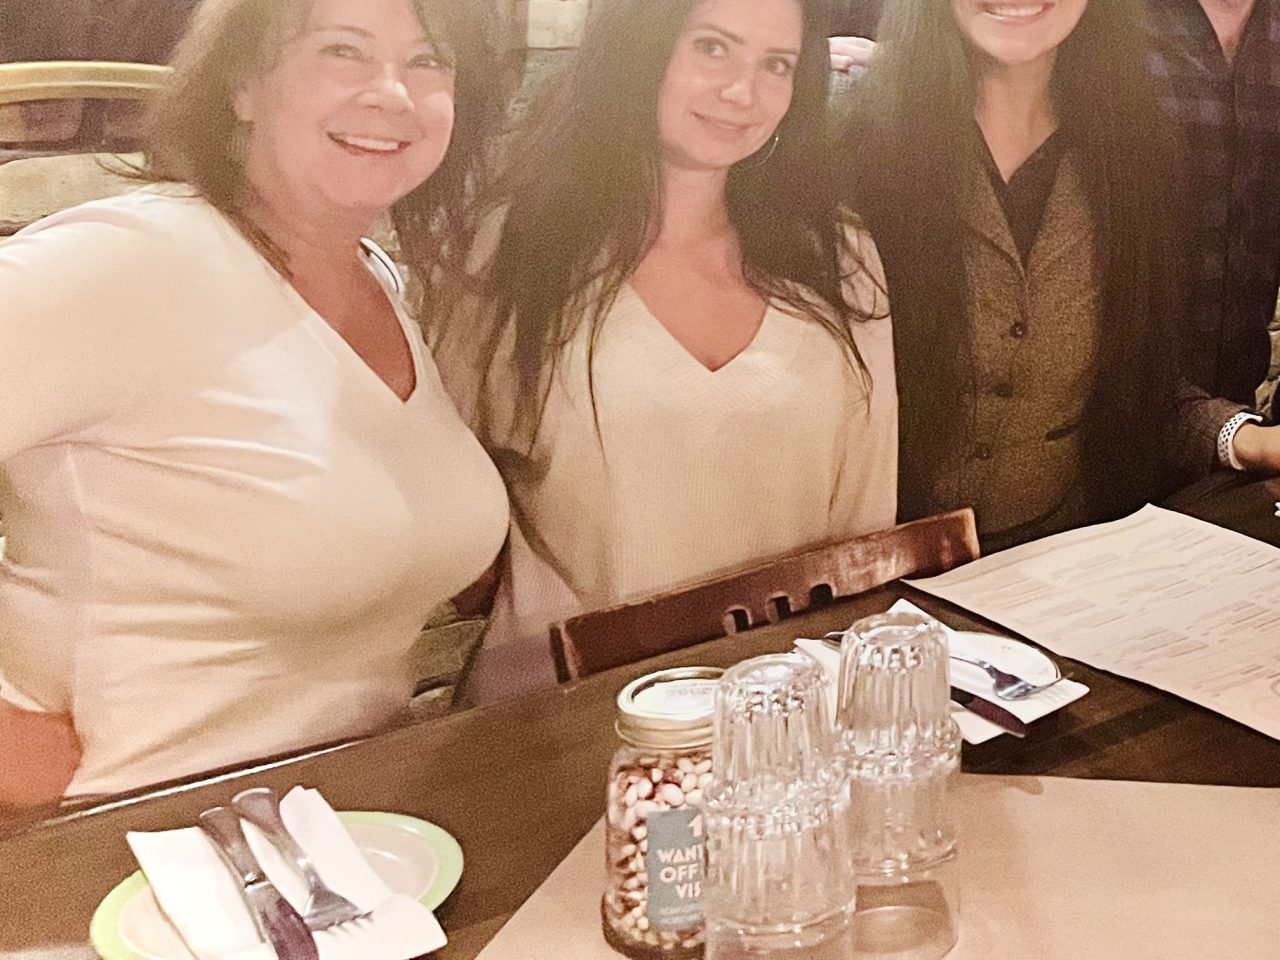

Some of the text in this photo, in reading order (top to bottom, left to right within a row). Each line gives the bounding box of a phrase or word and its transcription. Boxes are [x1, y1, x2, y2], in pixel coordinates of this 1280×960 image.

[657, 844, 703, 863] WANT
[660, 863, 699, 883] OFF
[675, 881, 702, 899] VIS
